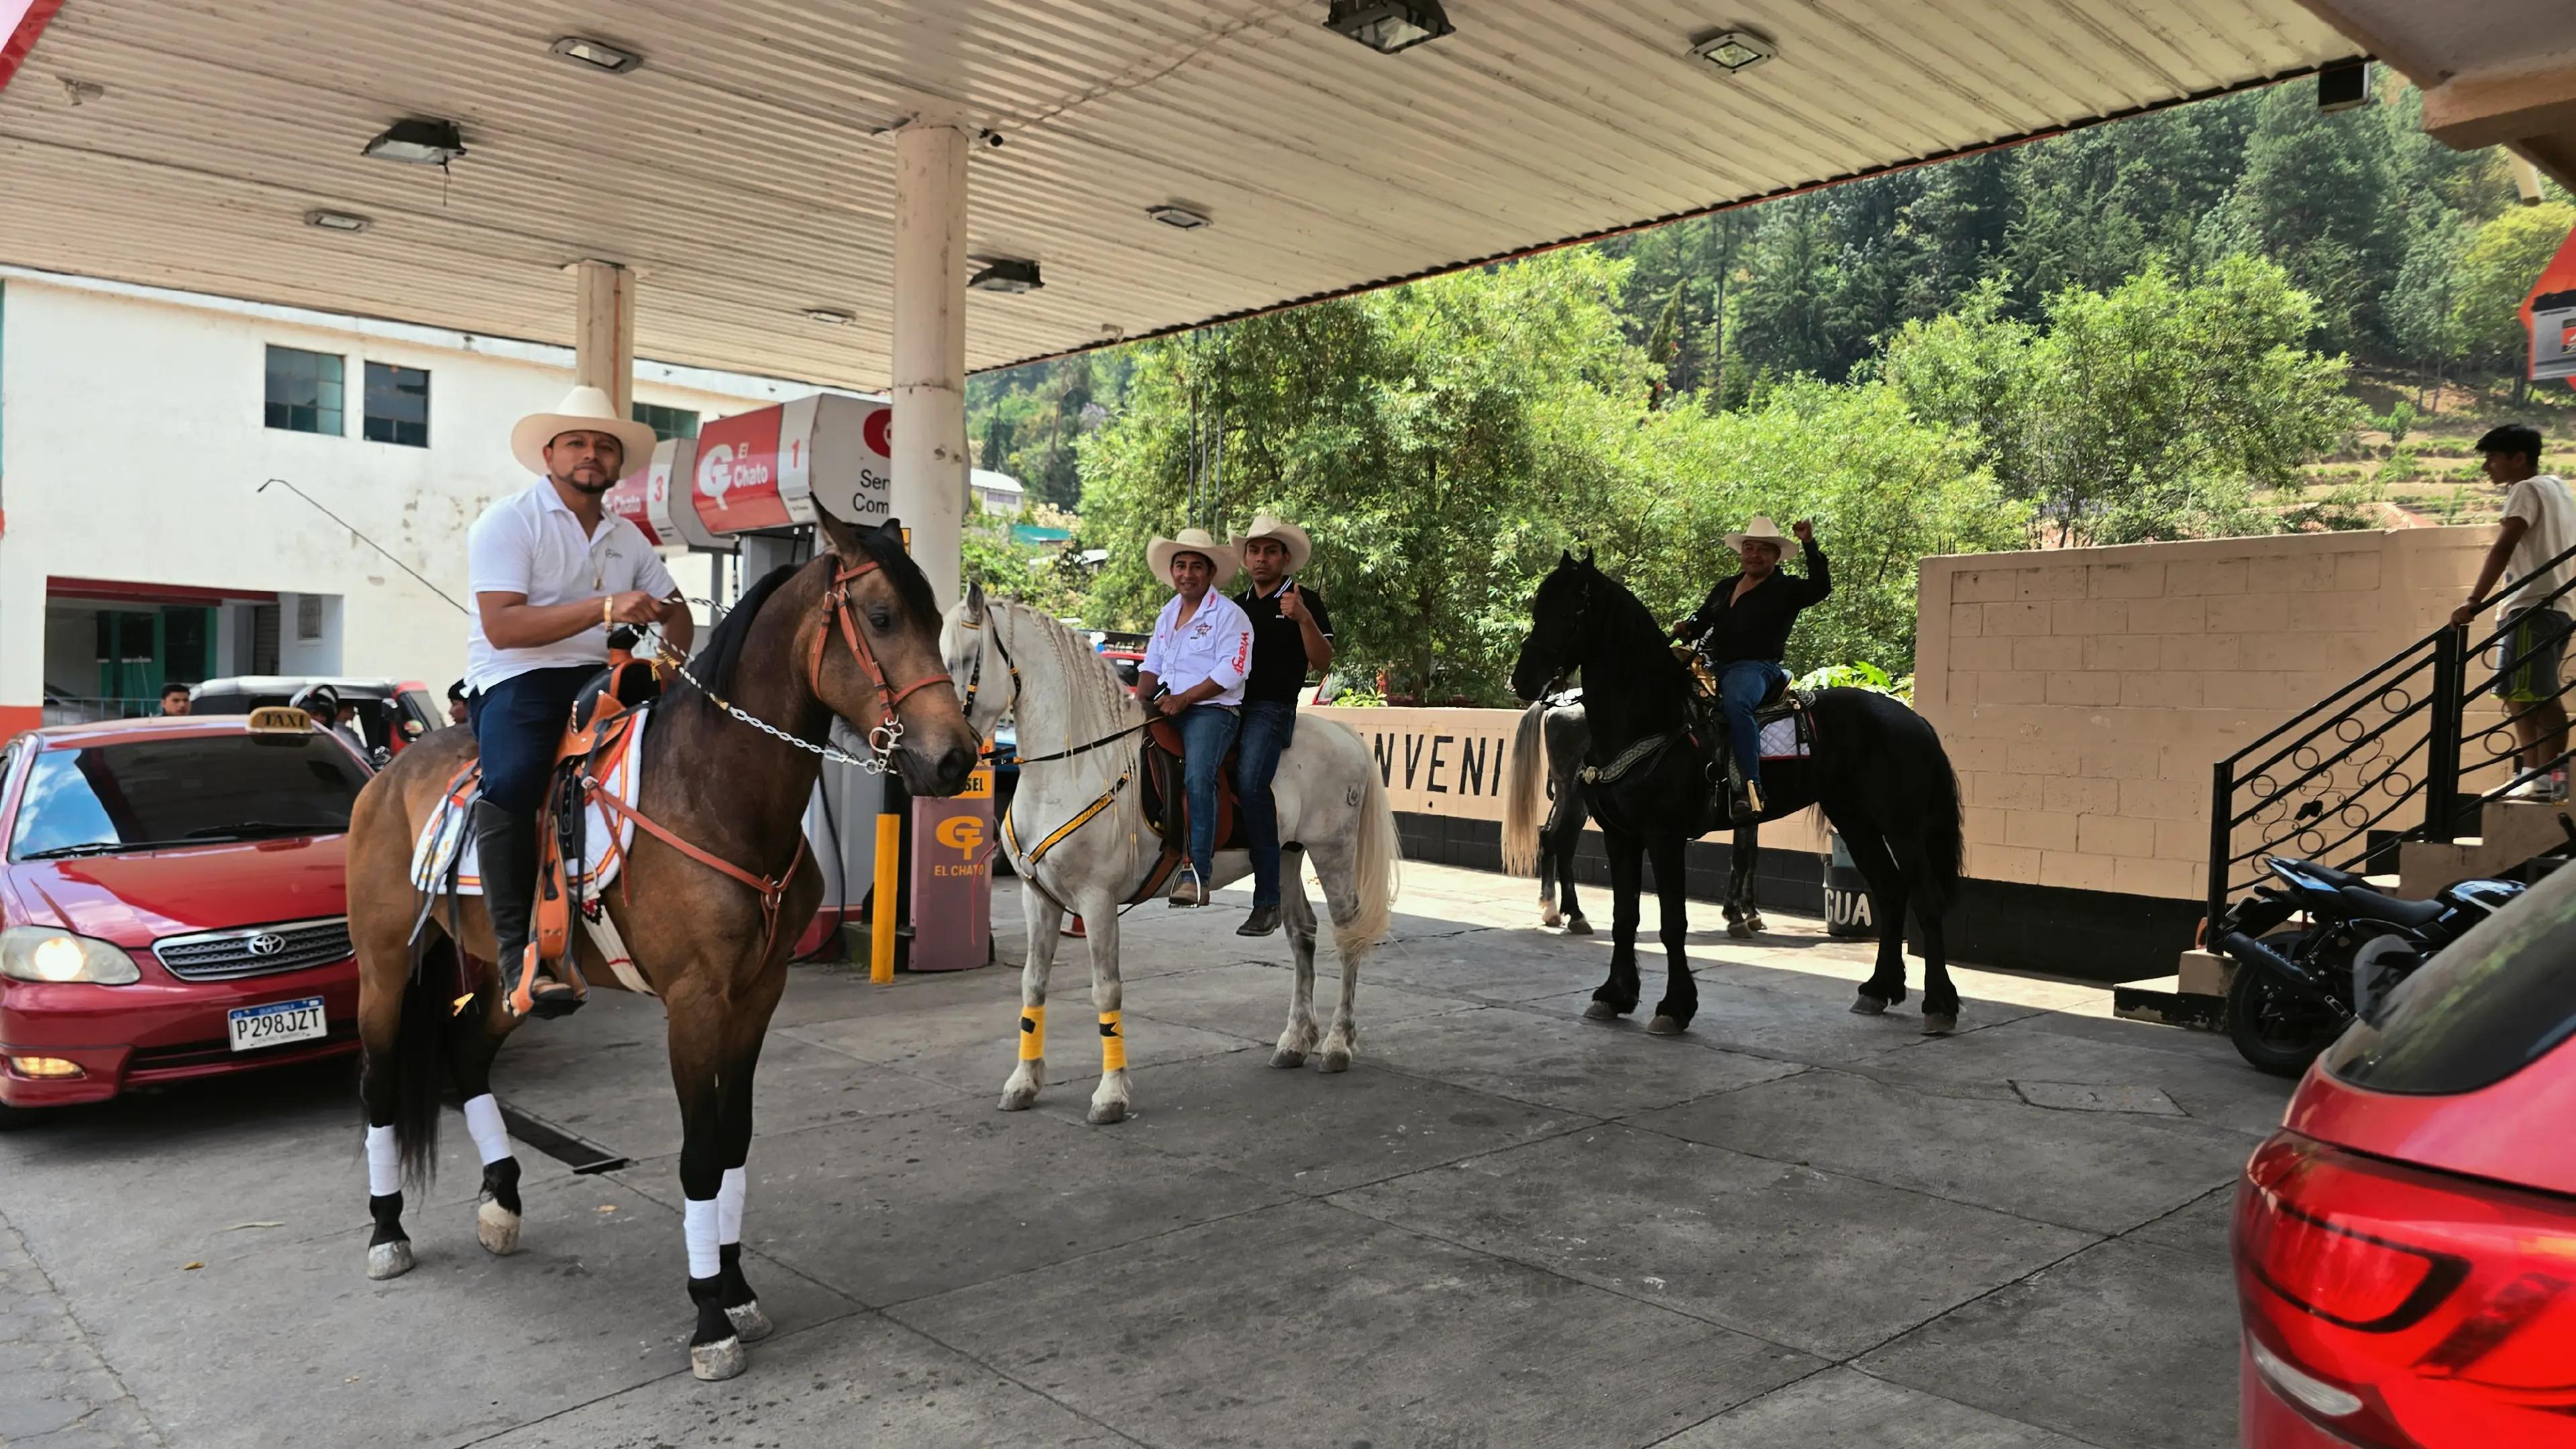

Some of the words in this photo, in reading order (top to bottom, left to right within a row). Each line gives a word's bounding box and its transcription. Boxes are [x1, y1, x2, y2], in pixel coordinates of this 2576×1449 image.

[739, 443, 749, 460] El
[792, 439, 800, 469] 1
[734, 464, 768, 488] Chato
[655, 476, 663, 502] 3
[262, 712, 305, 728] TAXI
[1360, 732, 1505, 797] NVENI
[934, 865, 948, 876] EL
